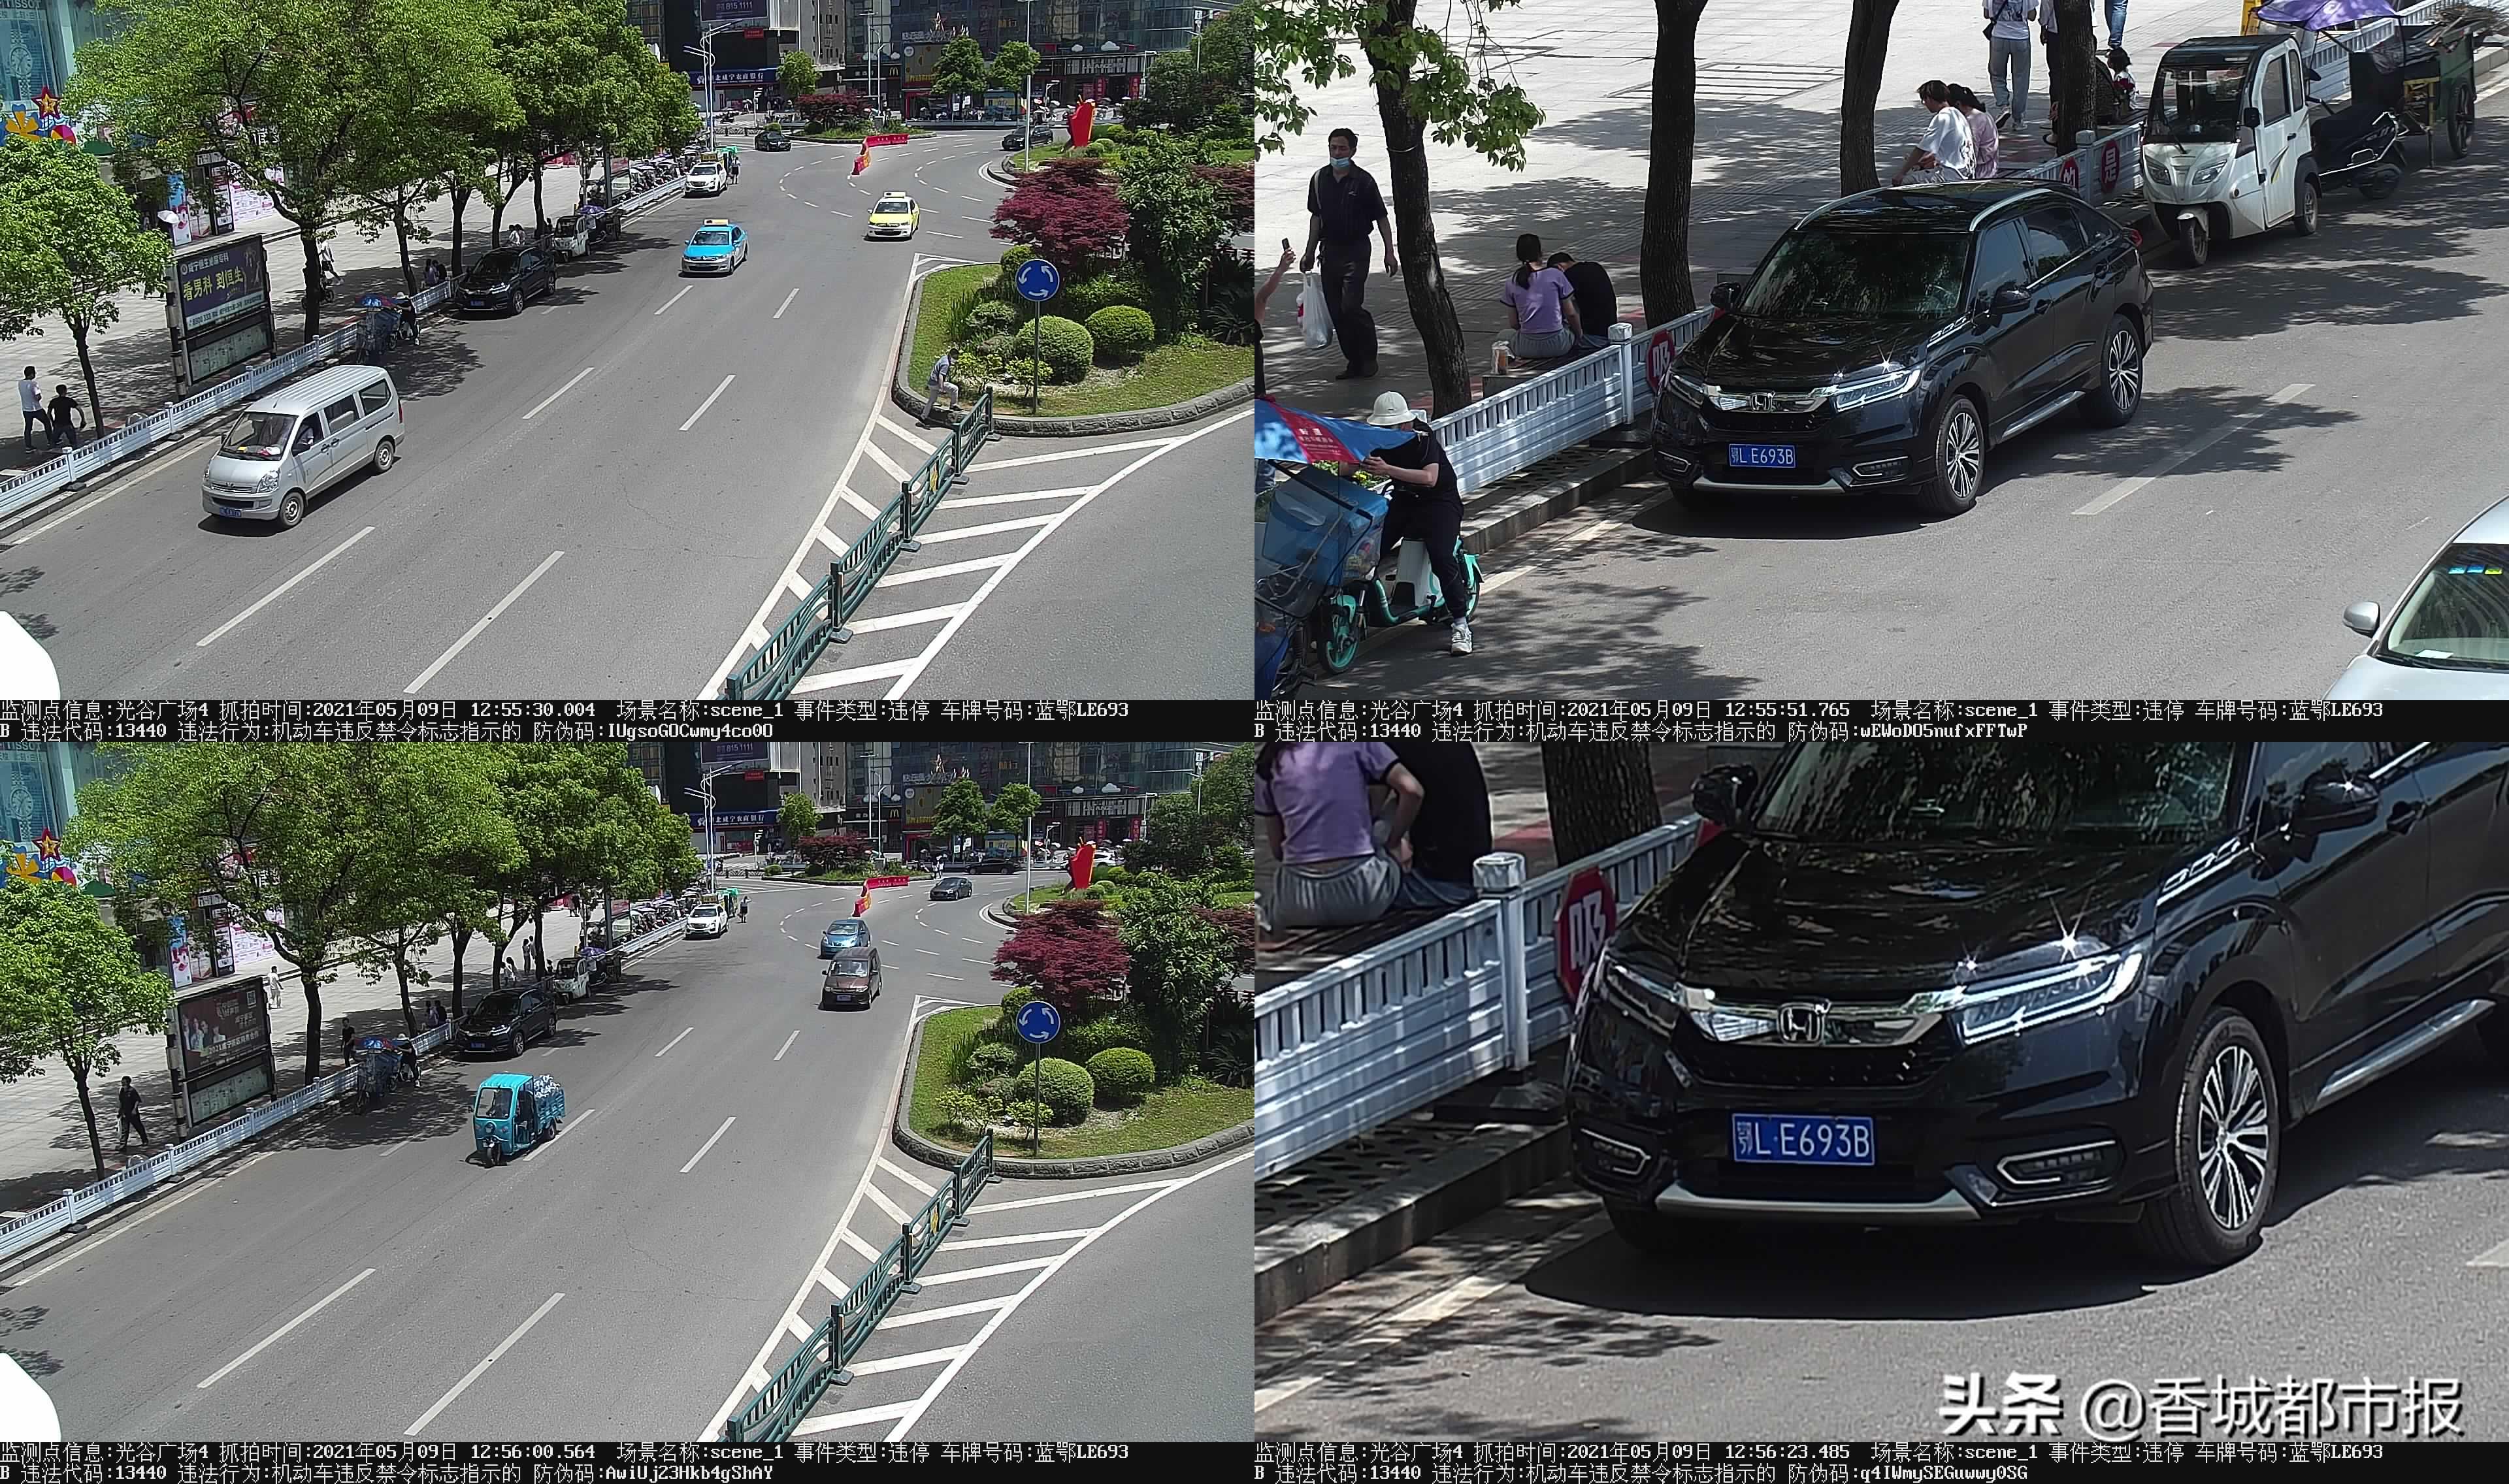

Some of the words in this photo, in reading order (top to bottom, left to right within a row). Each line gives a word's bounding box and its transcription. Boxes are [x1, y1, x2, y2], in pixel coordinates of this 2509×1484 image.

[708, 73, 764, 81] 北咸宁农商银行
[709, 815, 764, 823] 北咸宁农商银行
